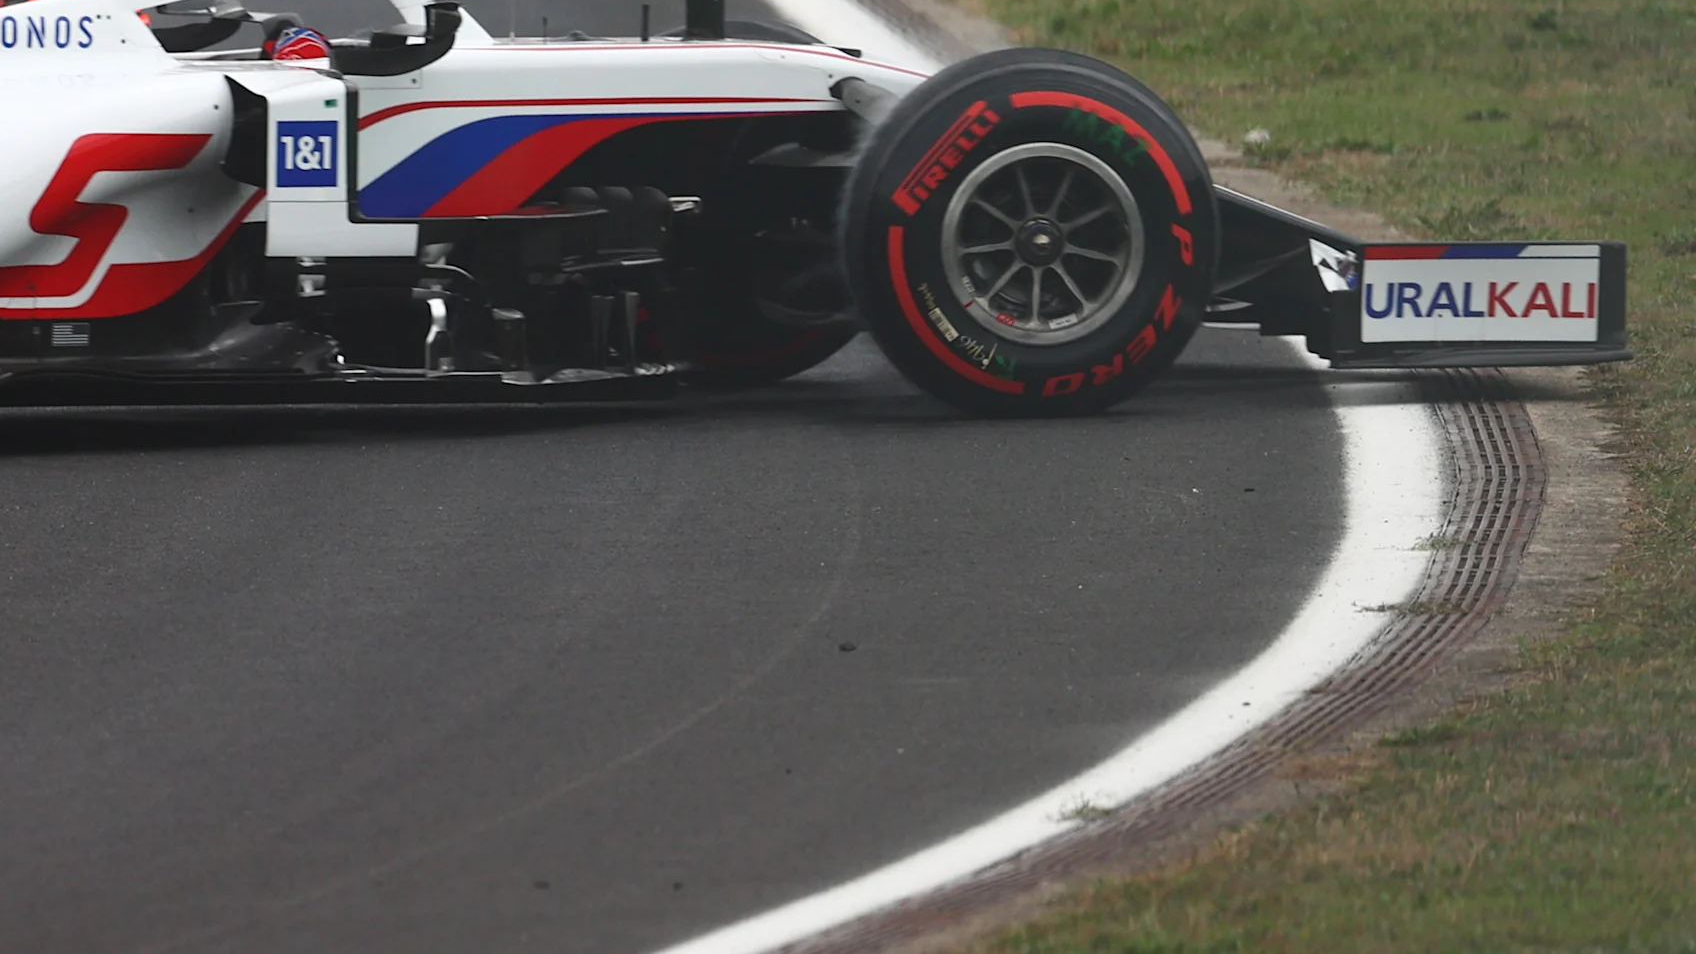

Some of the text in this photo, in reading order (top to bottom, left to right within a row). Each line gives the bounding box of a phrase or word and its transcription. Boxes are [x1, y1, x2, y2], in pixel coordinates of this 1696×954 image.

[281, 136, 332, 170] 1&1
[891, 100, 1001, 216] PIRELLI
[1041, 223, 1194, 398] P ZERO
[1364, 282, 1596, 319] URALKALI
